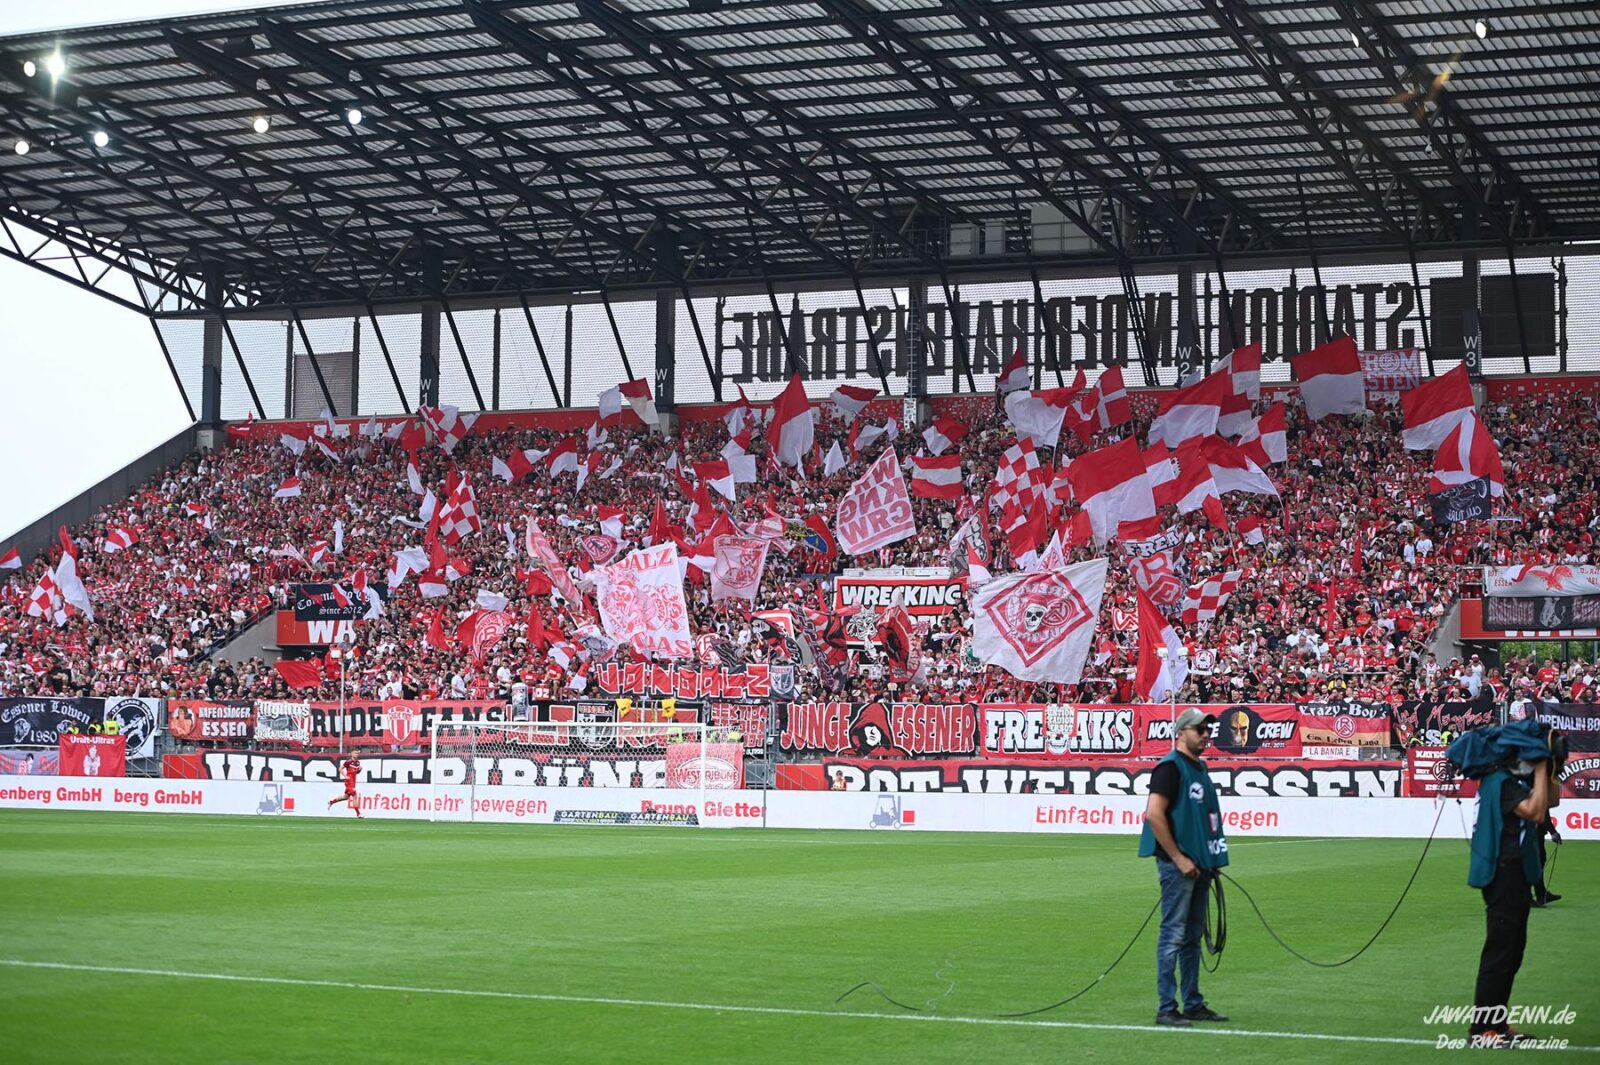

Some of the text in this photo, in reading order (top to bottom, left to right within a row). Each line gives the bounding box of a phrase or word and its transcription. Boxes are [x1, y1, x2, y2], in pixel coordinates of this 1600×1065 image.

[1464, 336, 1477, 366] W 3
[1179, 347, 1191, 377] W 2
[655, 369, 667, 381] W
[420, 379, 431, 390] W
[841, 585, 960, 606] WRECKING
[342, 606, 363, 614] 2012
[0, 700, 91, 725] Essener Löwen
[202, 722, 247, 737] ESSEN
[312, 706, 383, 737] RUDE
[420, 706, 501, 737] FANS
[781, 702, 976, 754] JUNGE ESSENER
[30, 729, 58, 743] 1980
[986, 709, 1134, 754] FREAKS
[1256, 722, 1295, 739] CREW
[1208, 770, 1399, 797] ESSEN
[0, 786, 102, 803] enberg GmbH
[114, 789, 202, 806] berg GmbH
[561, 811, 617, 819] GARTENBAU
[630, 813, 688, 821] GARTENBAU
[1036, 805, 1114, 824] Einfach
